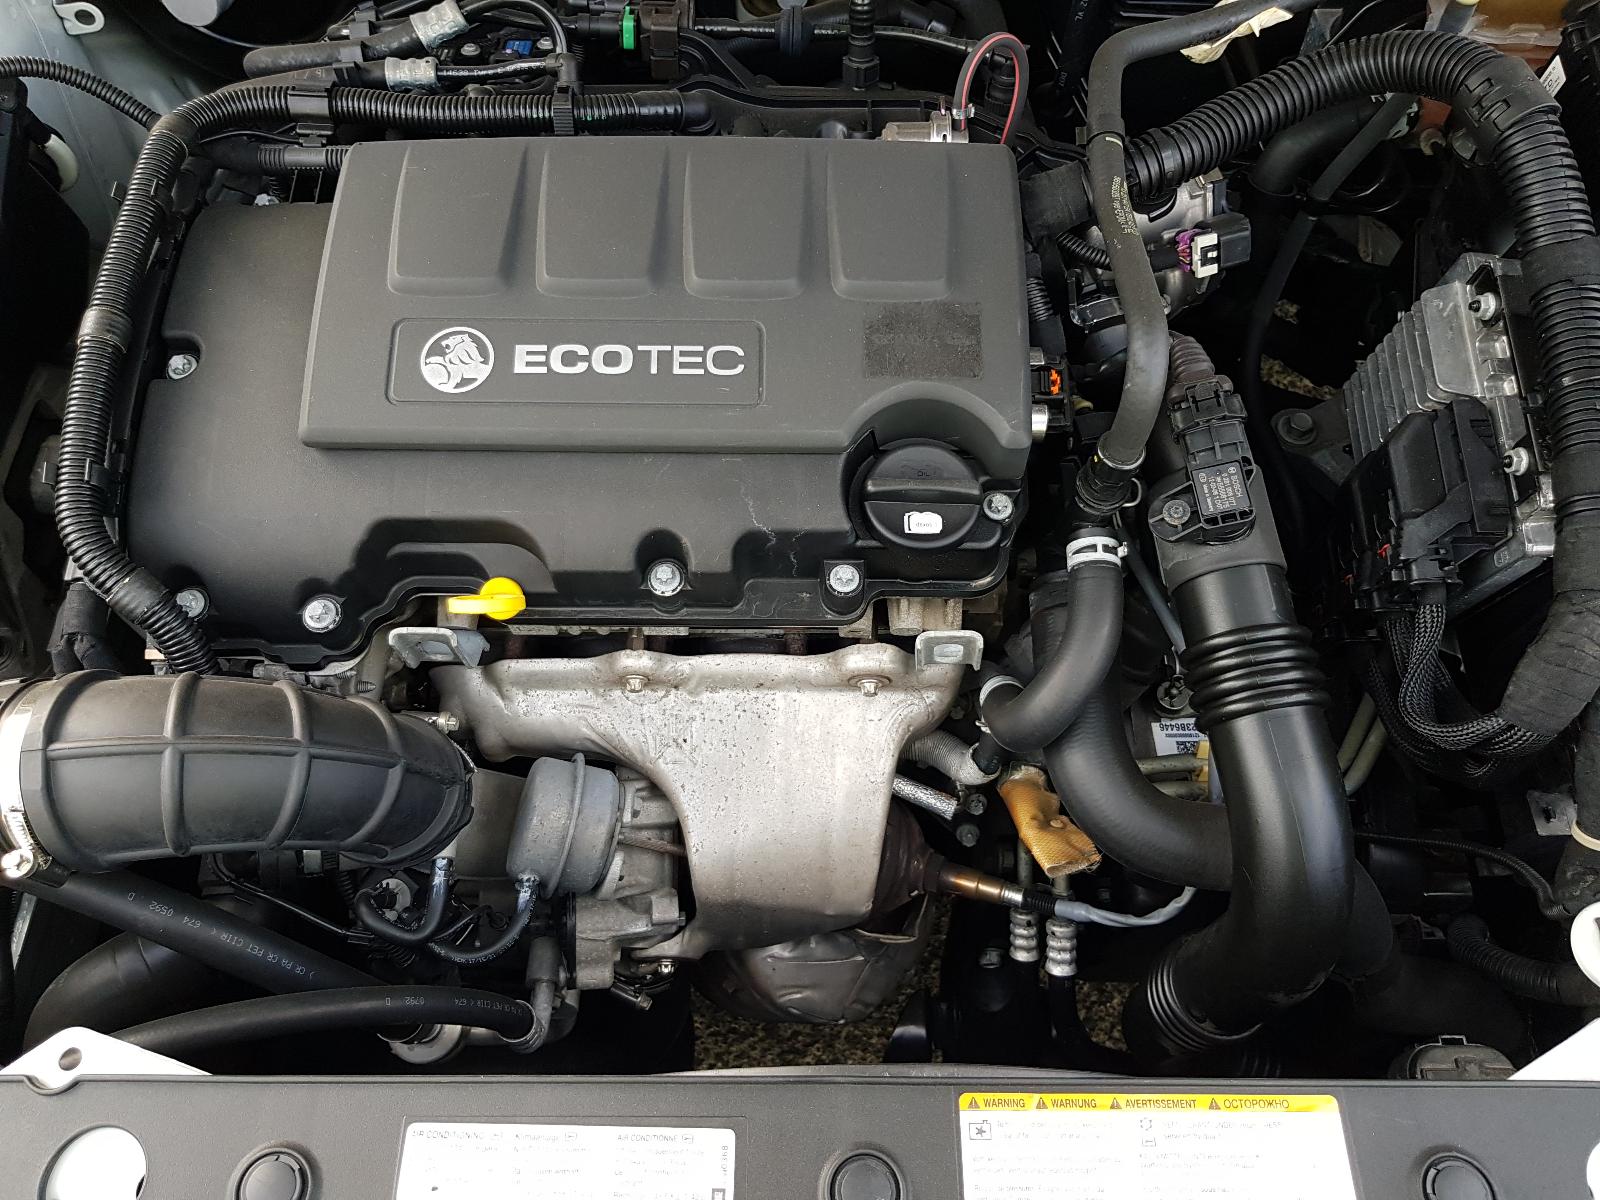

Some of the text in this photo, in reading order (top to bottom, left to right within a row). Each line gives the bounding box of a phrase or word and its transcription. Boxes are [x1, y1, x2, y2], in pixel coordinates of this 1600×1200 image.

[514, 344, 745, 376] ECOTEC
[1231, 475, 1243, 497] BOSCH
[983, 1097, 1197, 1109] WARNING WARNUNG AVERTISSEMENT
[1223, 1099, 1290, 1110] ОСТОРОЖНО
